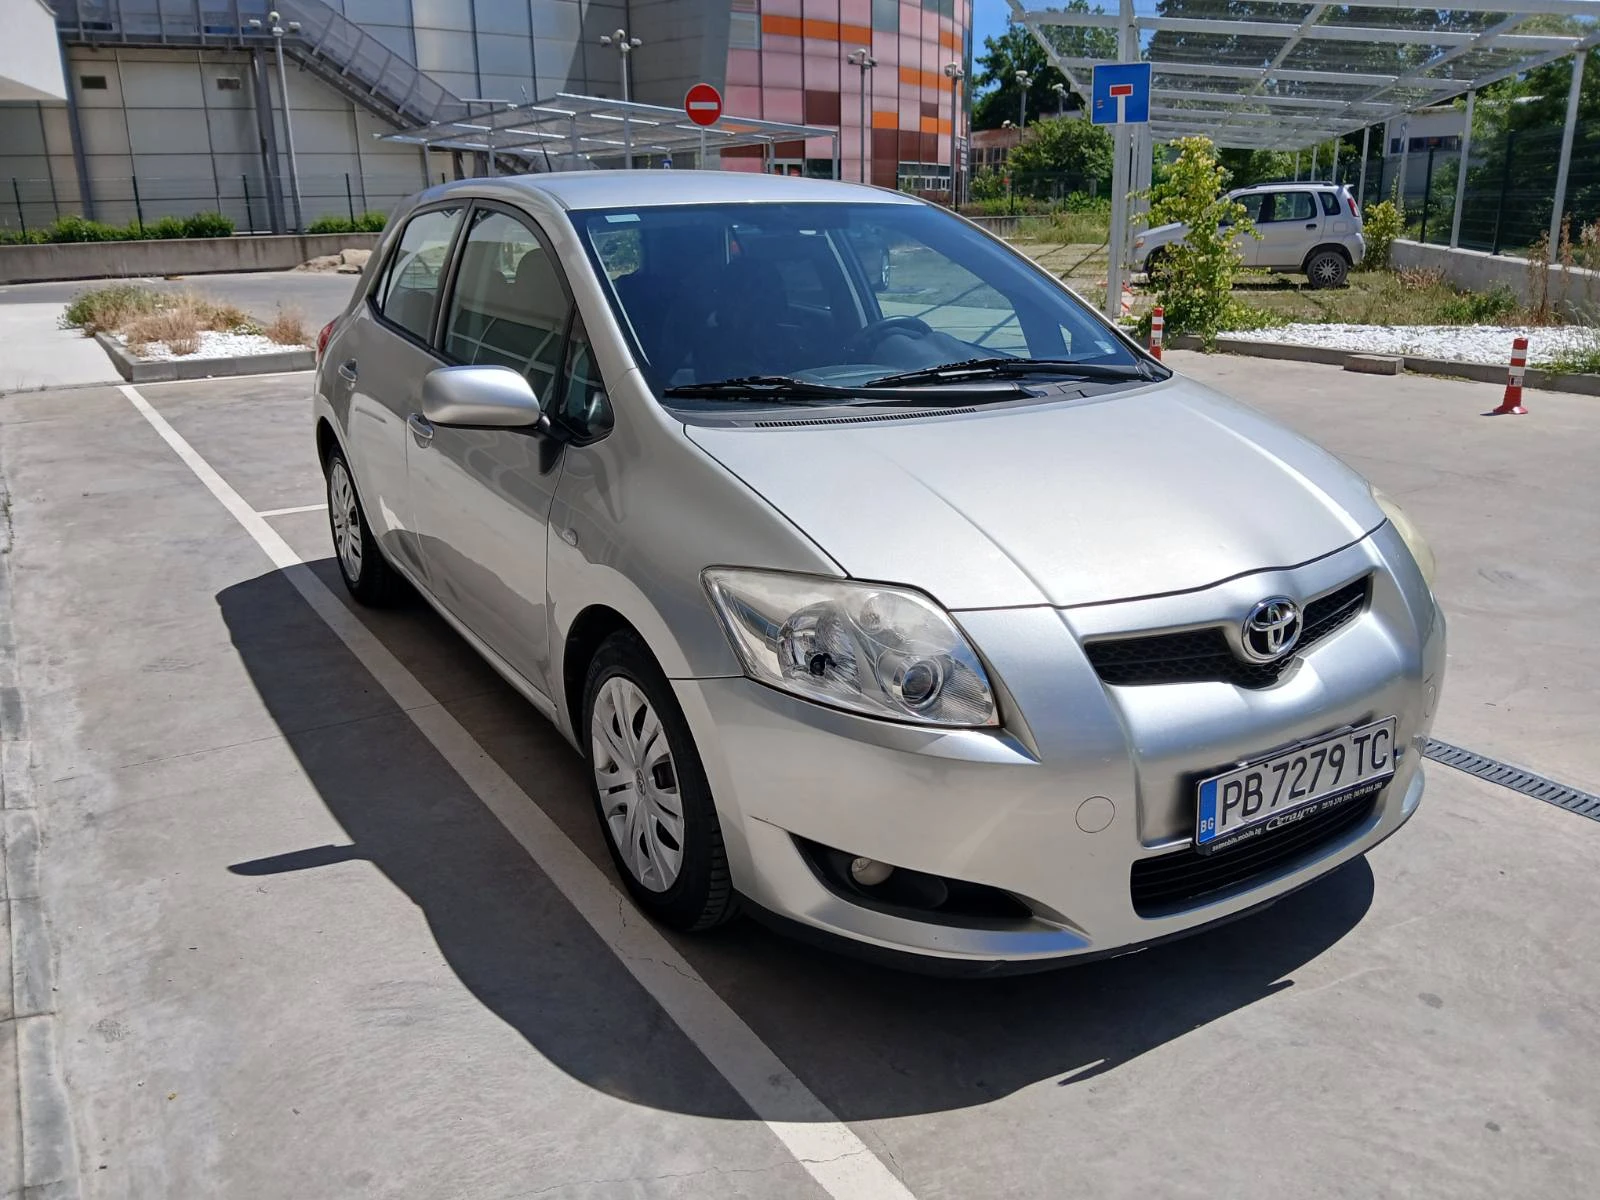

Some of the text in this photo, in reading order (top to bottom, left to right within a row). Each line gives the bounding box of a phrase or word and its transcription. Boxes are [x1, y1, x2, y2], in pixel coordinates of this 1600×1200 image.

[1221, 772, 1263, 826] PB
[1270, 744, 1346, 807] 7279
[1353, 728, 1389, 776] TC
[1200, 817, 1215, 833] BG
